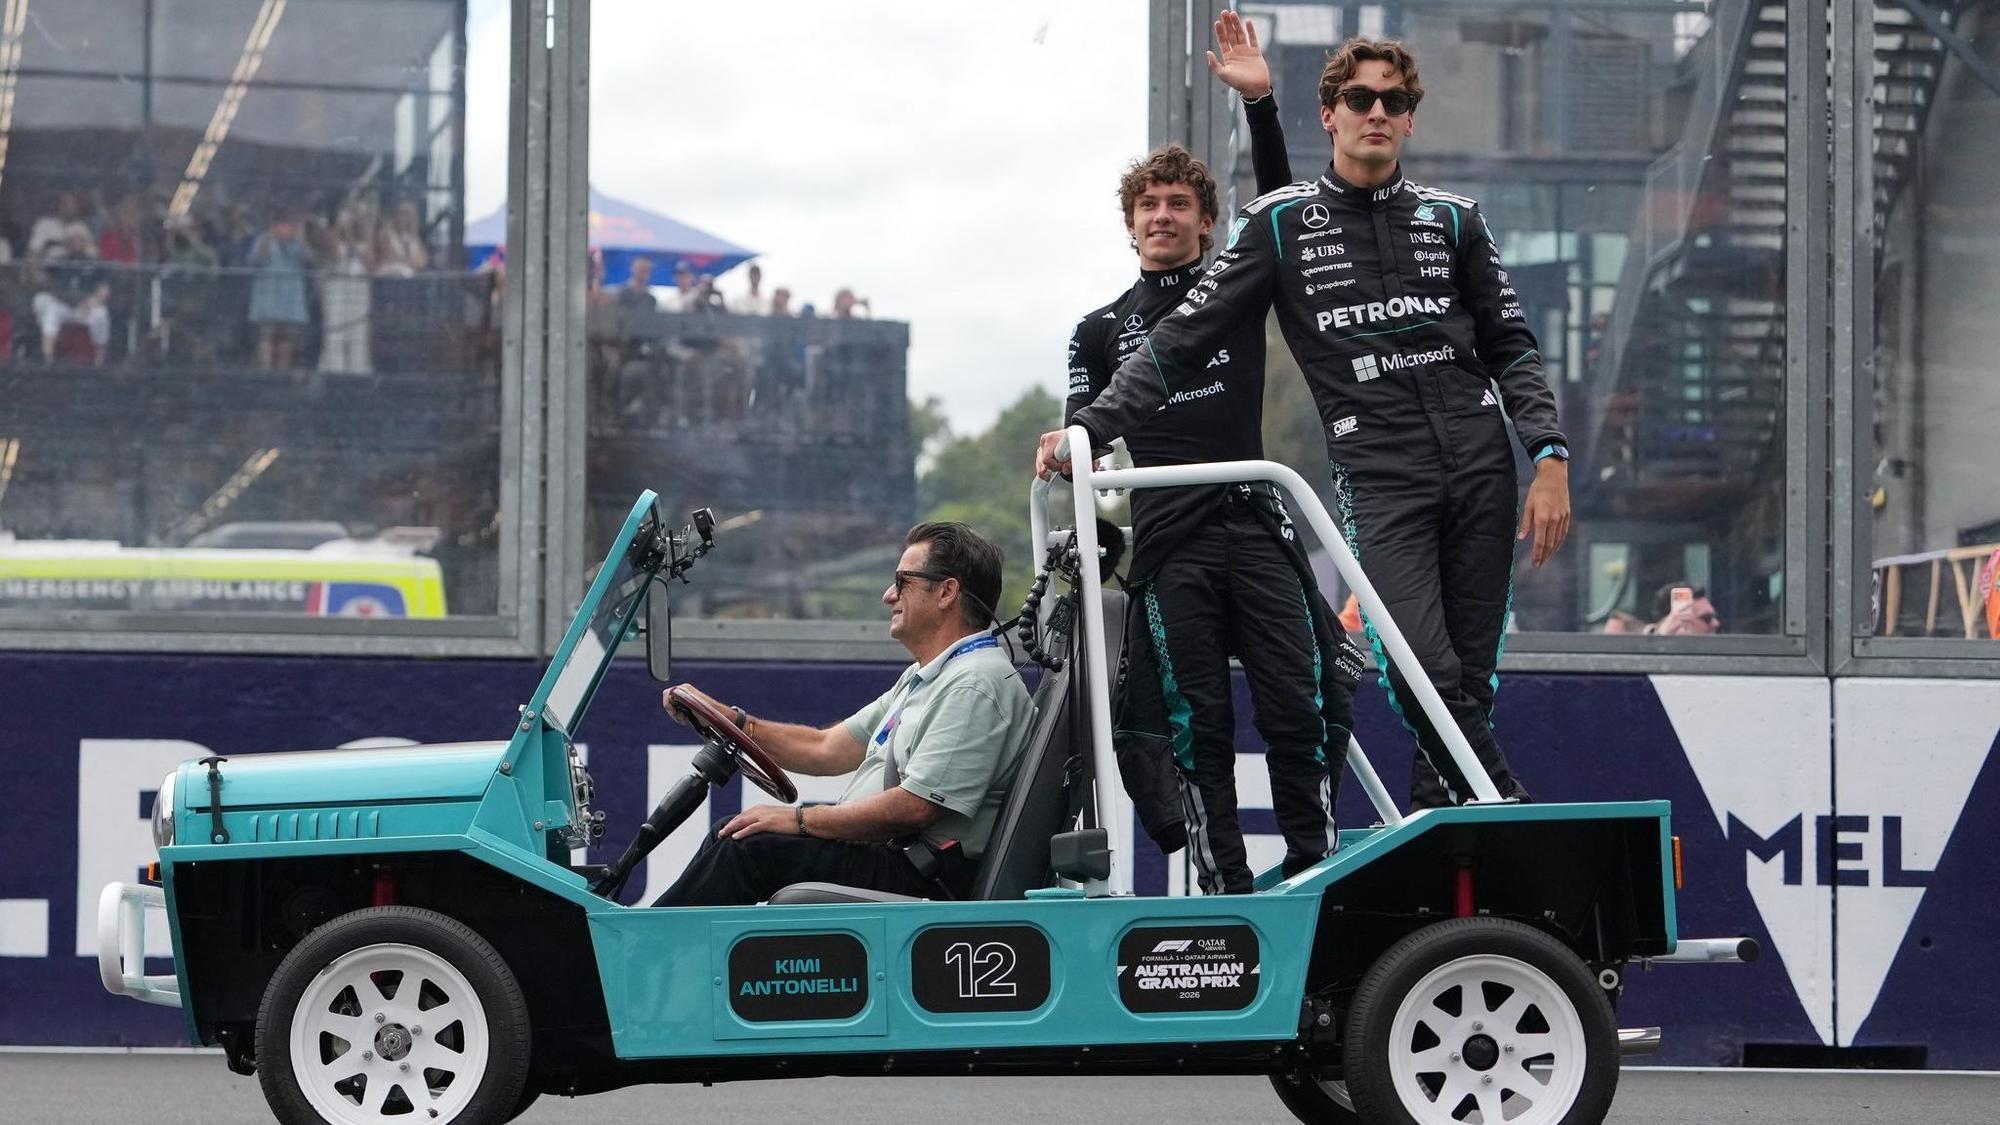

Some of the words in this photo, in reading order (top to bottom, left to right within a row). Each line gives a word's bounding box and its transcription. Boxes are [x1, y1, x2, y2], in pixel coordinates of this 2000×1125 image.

[1411, 220, 1444, 228] PETRONAS
[1316, 243, 1345, 257] UBS
[1304, 262, 1353, 275] CROWDSTRIKE
[1420, 266, 1450, 278] HPE
[1316, 279, 1356, 291] Snapdragon
[1316, 295, 1451, 332] PETRONAS
[1381, 345, 1456, 372] Microsoft
[1169, 381, 1225, 404] Microsoft
[1333, 417, 1358, 436] OMP
[0, 579, 143, 600] MERGENCY
[151, 579, 307, 600] AMBULANCE
[1727, 811, 1936, 887] MEL
[1198, 939, 1226, 947] QATAR
[775, 958, 821, 974] KIMI
[945, 941, 1017, 998] 12
[1134, 963, 1244, 977] AUSTRALIAN
[739, 977, 858, 996] ANTONELLI
[1138, 977, 1198, 989] GRAND
[1200, 975, 1240, 988] PRIX
[1179, 991, 1200, 999] 2026
